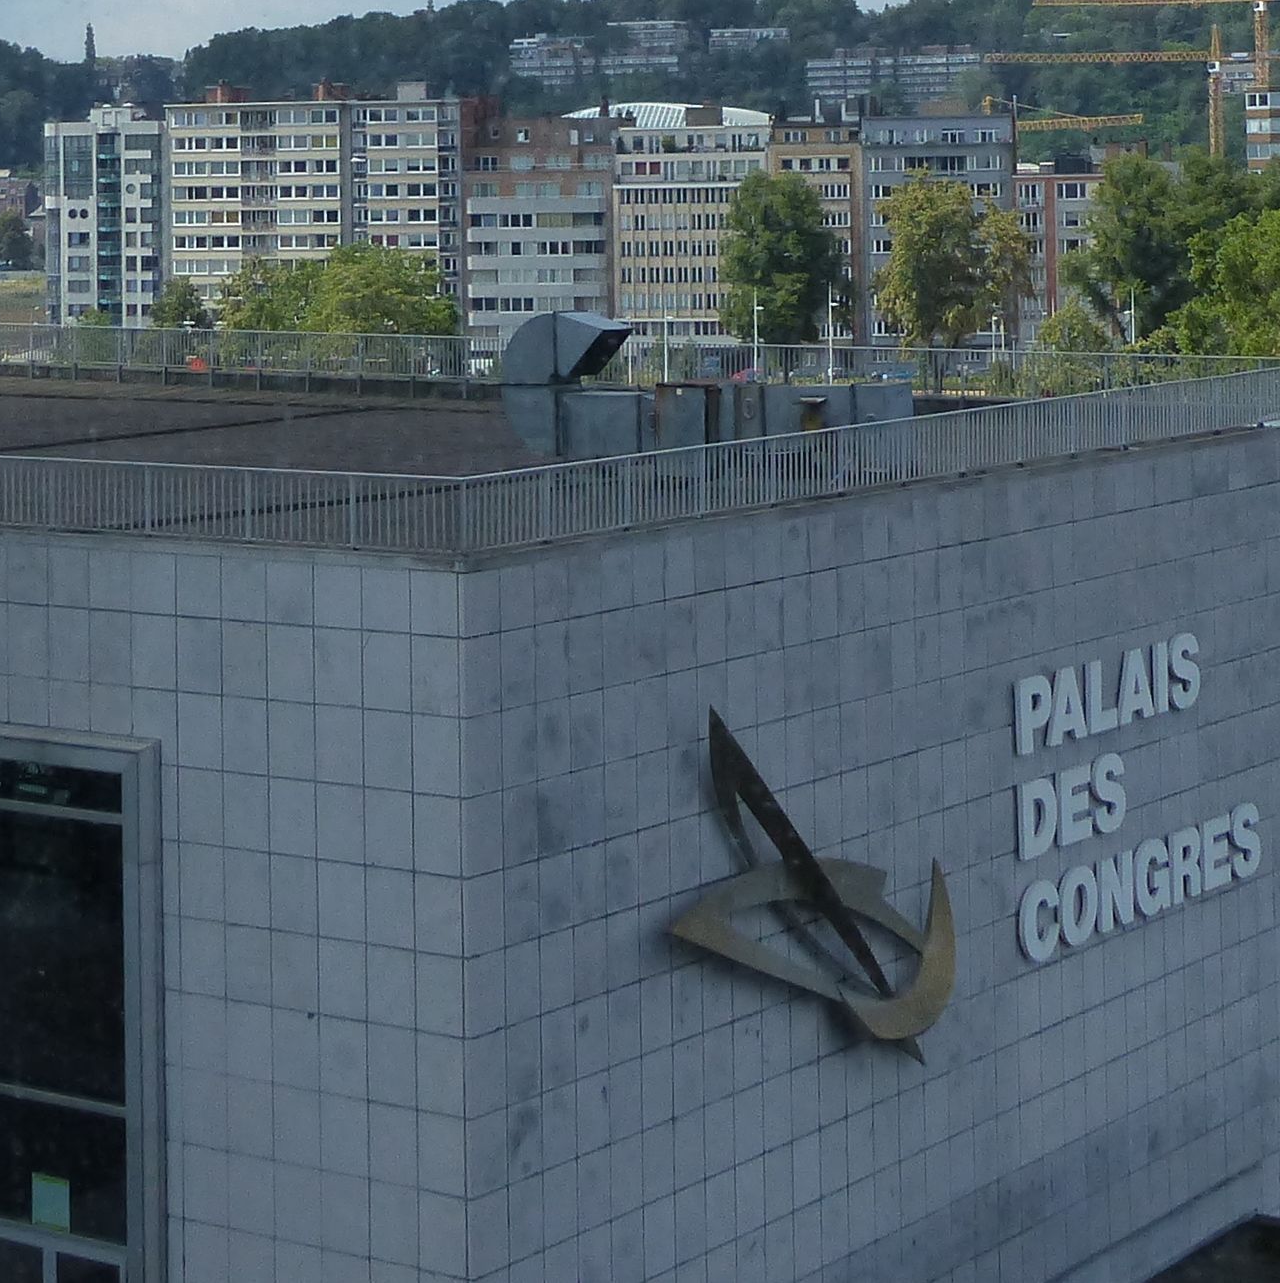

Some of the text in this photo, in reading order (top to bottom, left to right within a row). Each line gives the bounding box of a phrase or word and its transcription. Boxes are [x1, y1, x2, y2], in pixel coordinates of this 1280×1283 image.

[1014, 632, 1201, 756] PALAIS
[1017, 752, 1127, 862] DES
[1018, 802, 1261, 963] CONGRES
